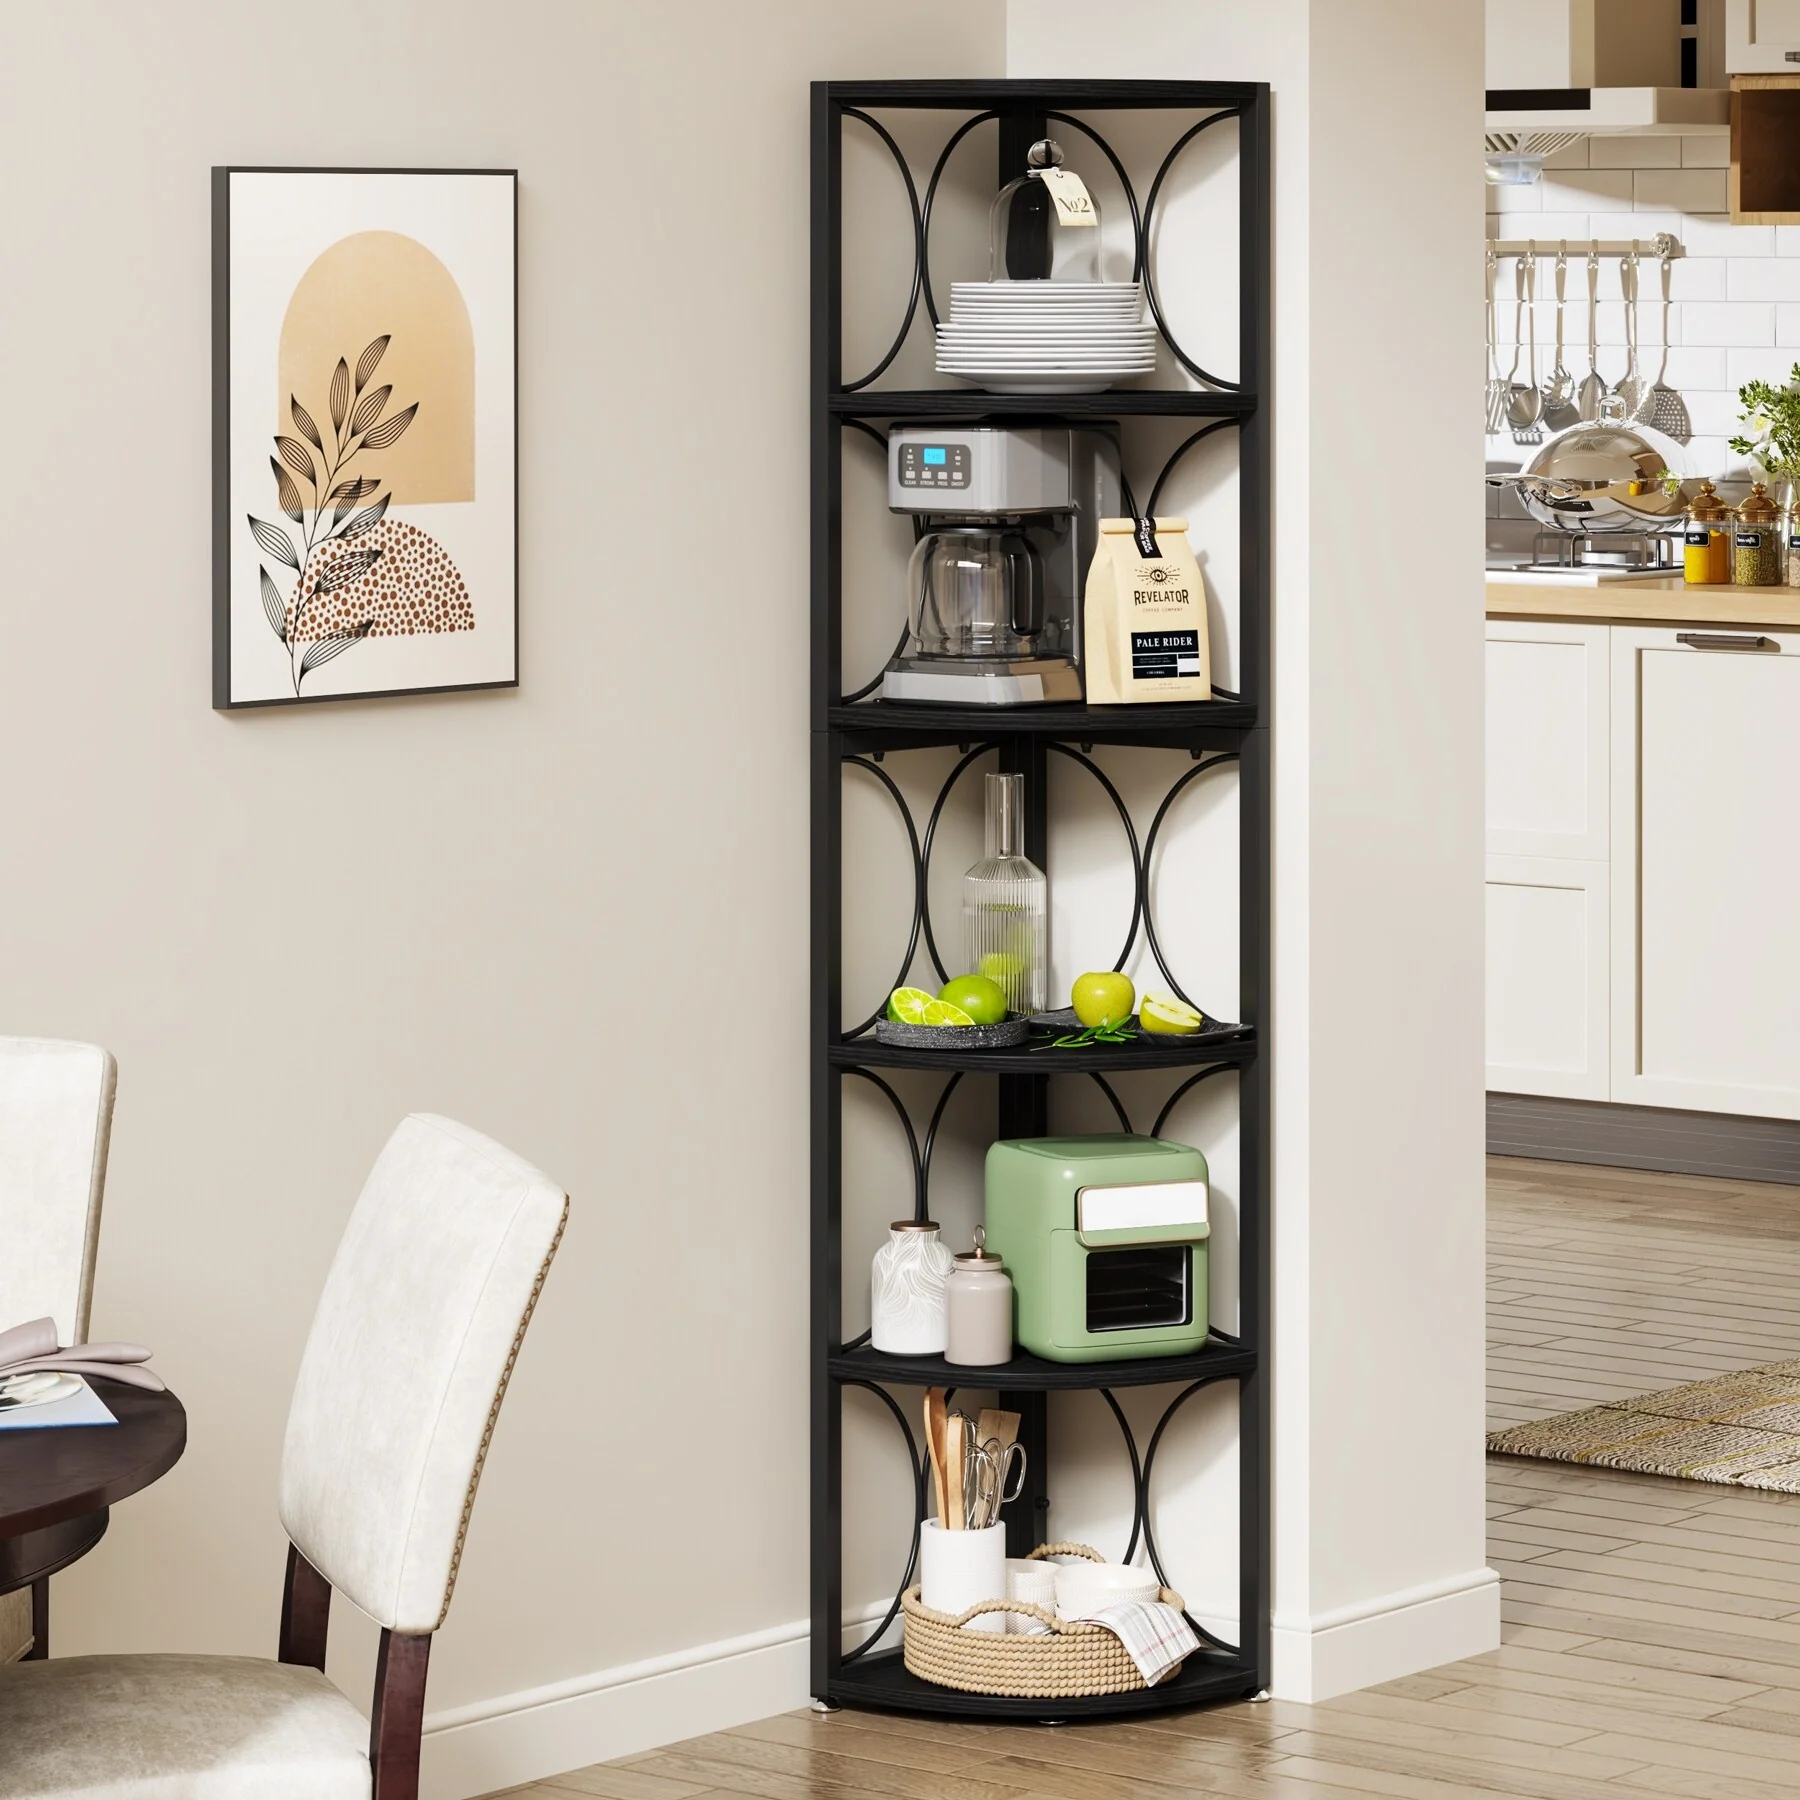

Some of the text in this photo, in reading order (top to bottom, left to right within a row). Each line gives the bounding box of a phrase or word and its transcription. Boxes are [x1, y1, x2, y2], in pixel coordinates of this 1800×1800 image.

[1133, 589, 1190, 606] REVELATOR
[1136, 636, 1193, 648] PALE RIDER
